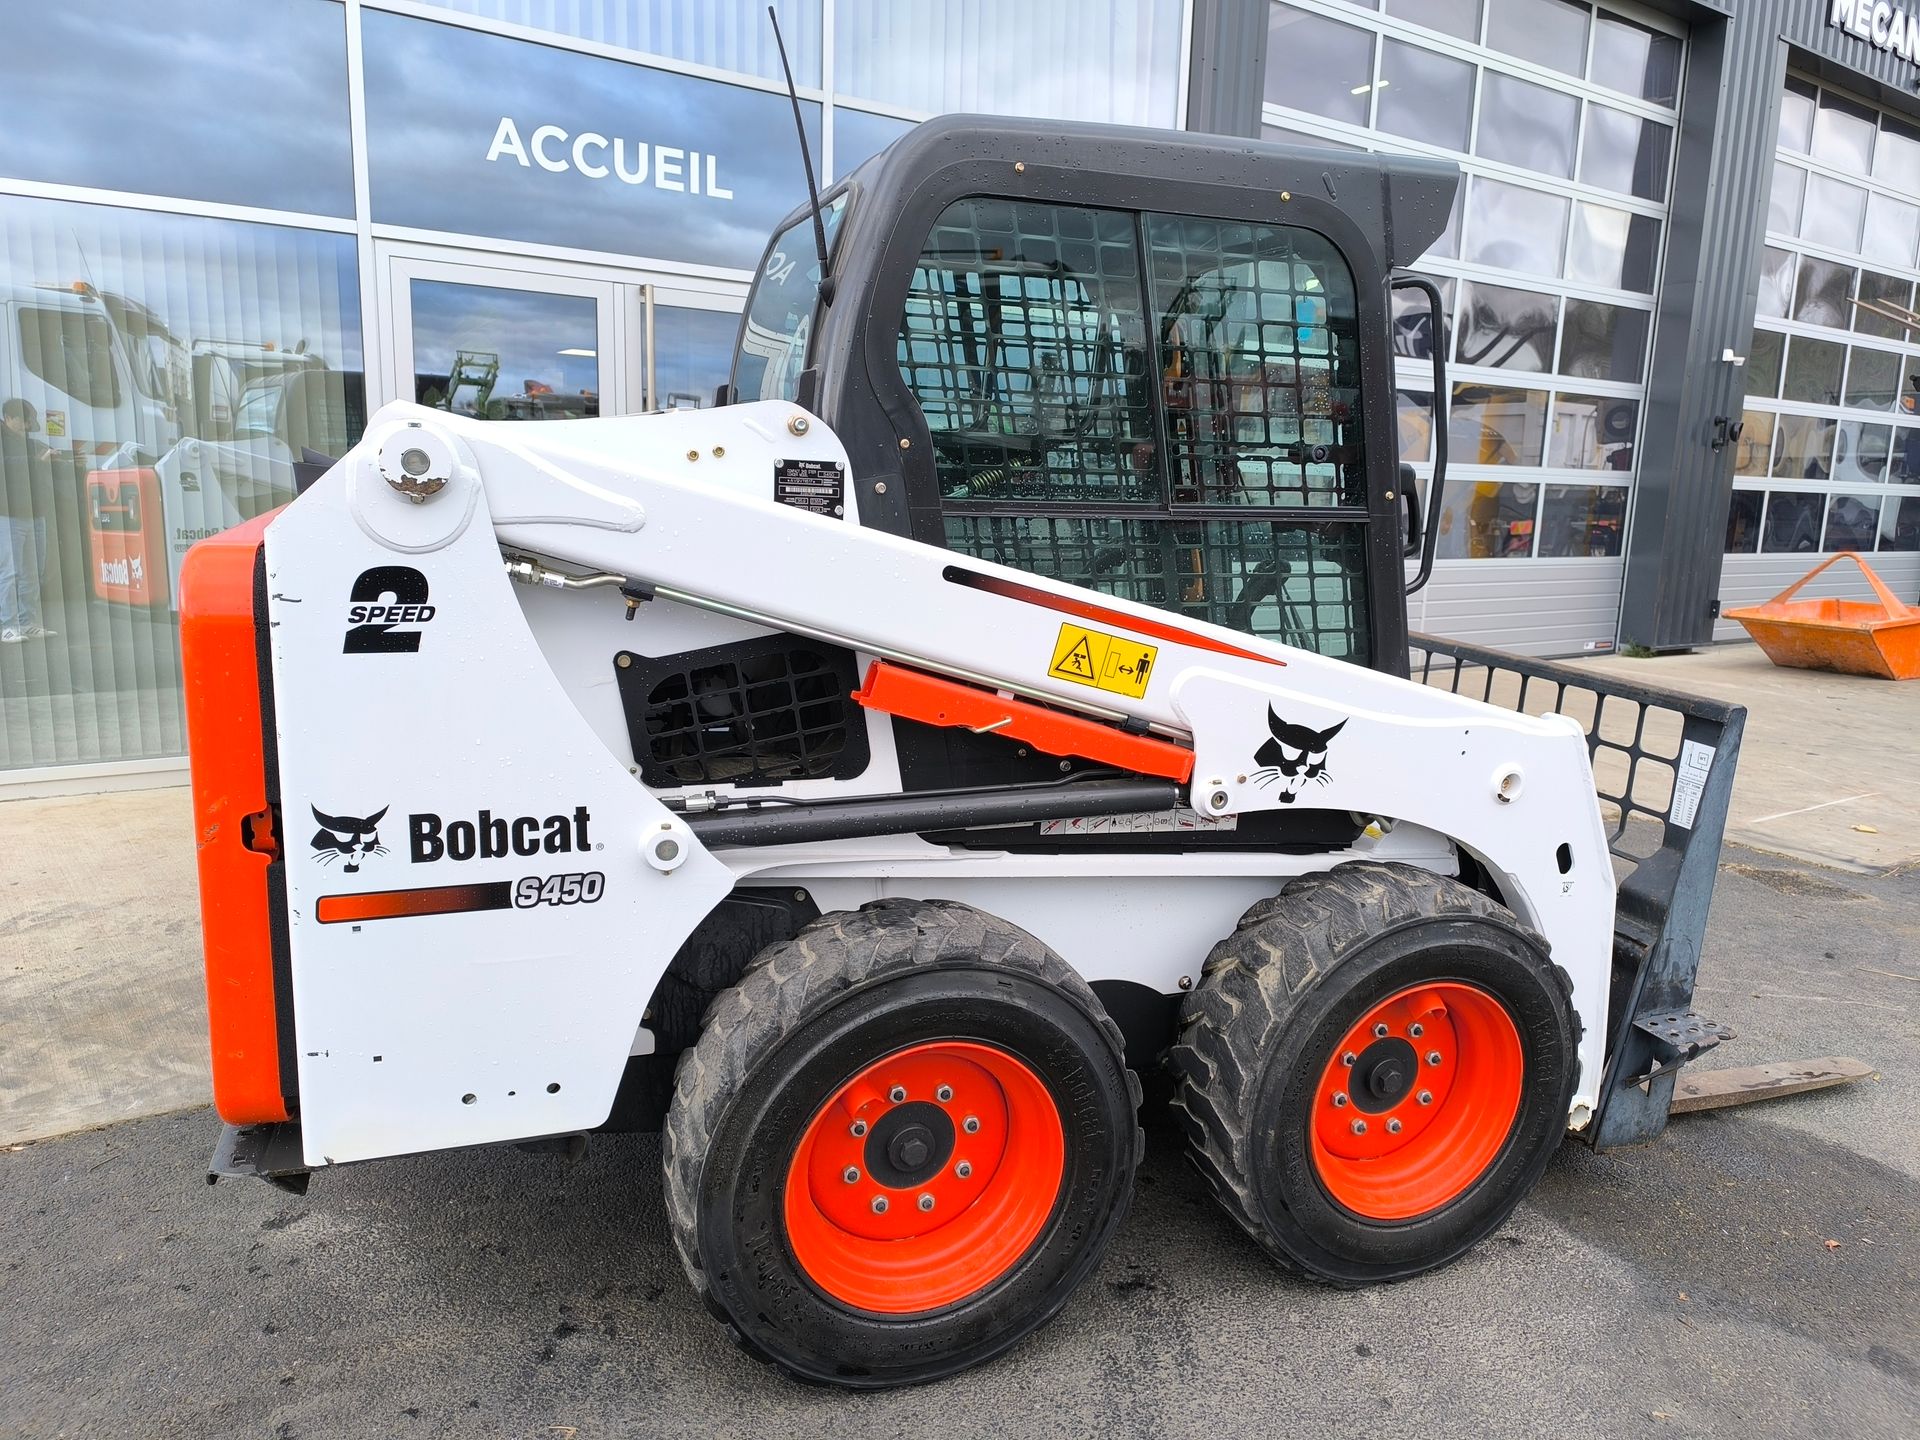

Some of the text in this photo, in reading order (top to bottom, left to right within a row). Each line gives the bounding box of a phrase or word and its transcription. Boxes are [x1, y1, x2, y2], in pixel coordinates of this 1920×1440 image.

[485, 116, 734, 200] ACCUEIL
[343, 566, 429, 654] 2
[348, 606, 435, 624] SPEED
[408, 806, 591, 864] Bobcat
[515, 871, 605, 909] S450
